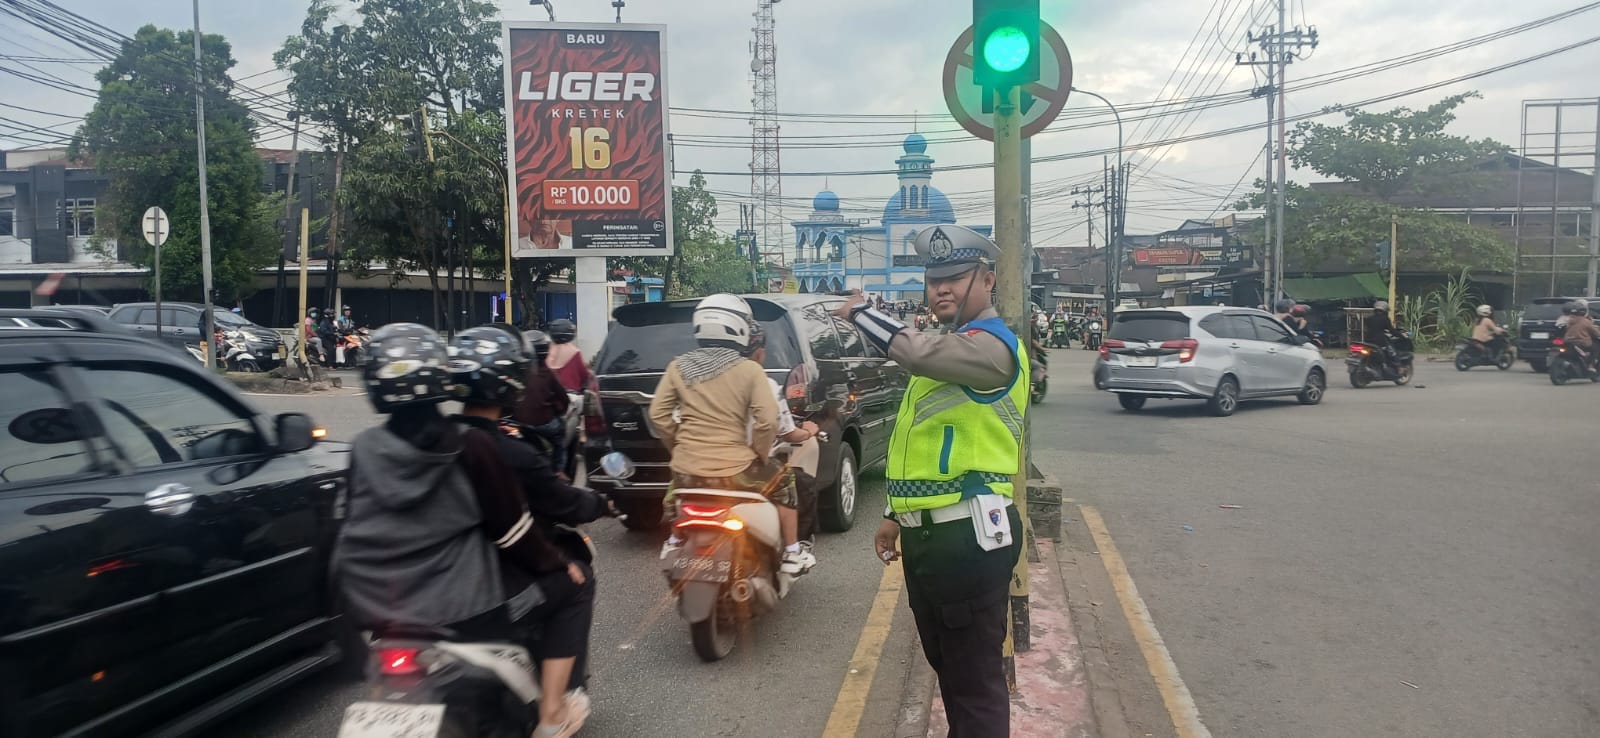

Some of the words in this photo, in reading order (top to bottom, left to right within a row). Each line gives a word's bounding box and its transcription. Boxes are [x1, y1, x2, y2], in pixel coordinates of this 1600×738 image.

[567, 34, 605, 44] BARU
[518, 71, 656, 101] LIGER
[552, 108, 625, 118] KRETEK
[569, 127, 610, 170] 16
[550, 187, 567, 197] RP
[569, 186, 631, 205] 10.000
